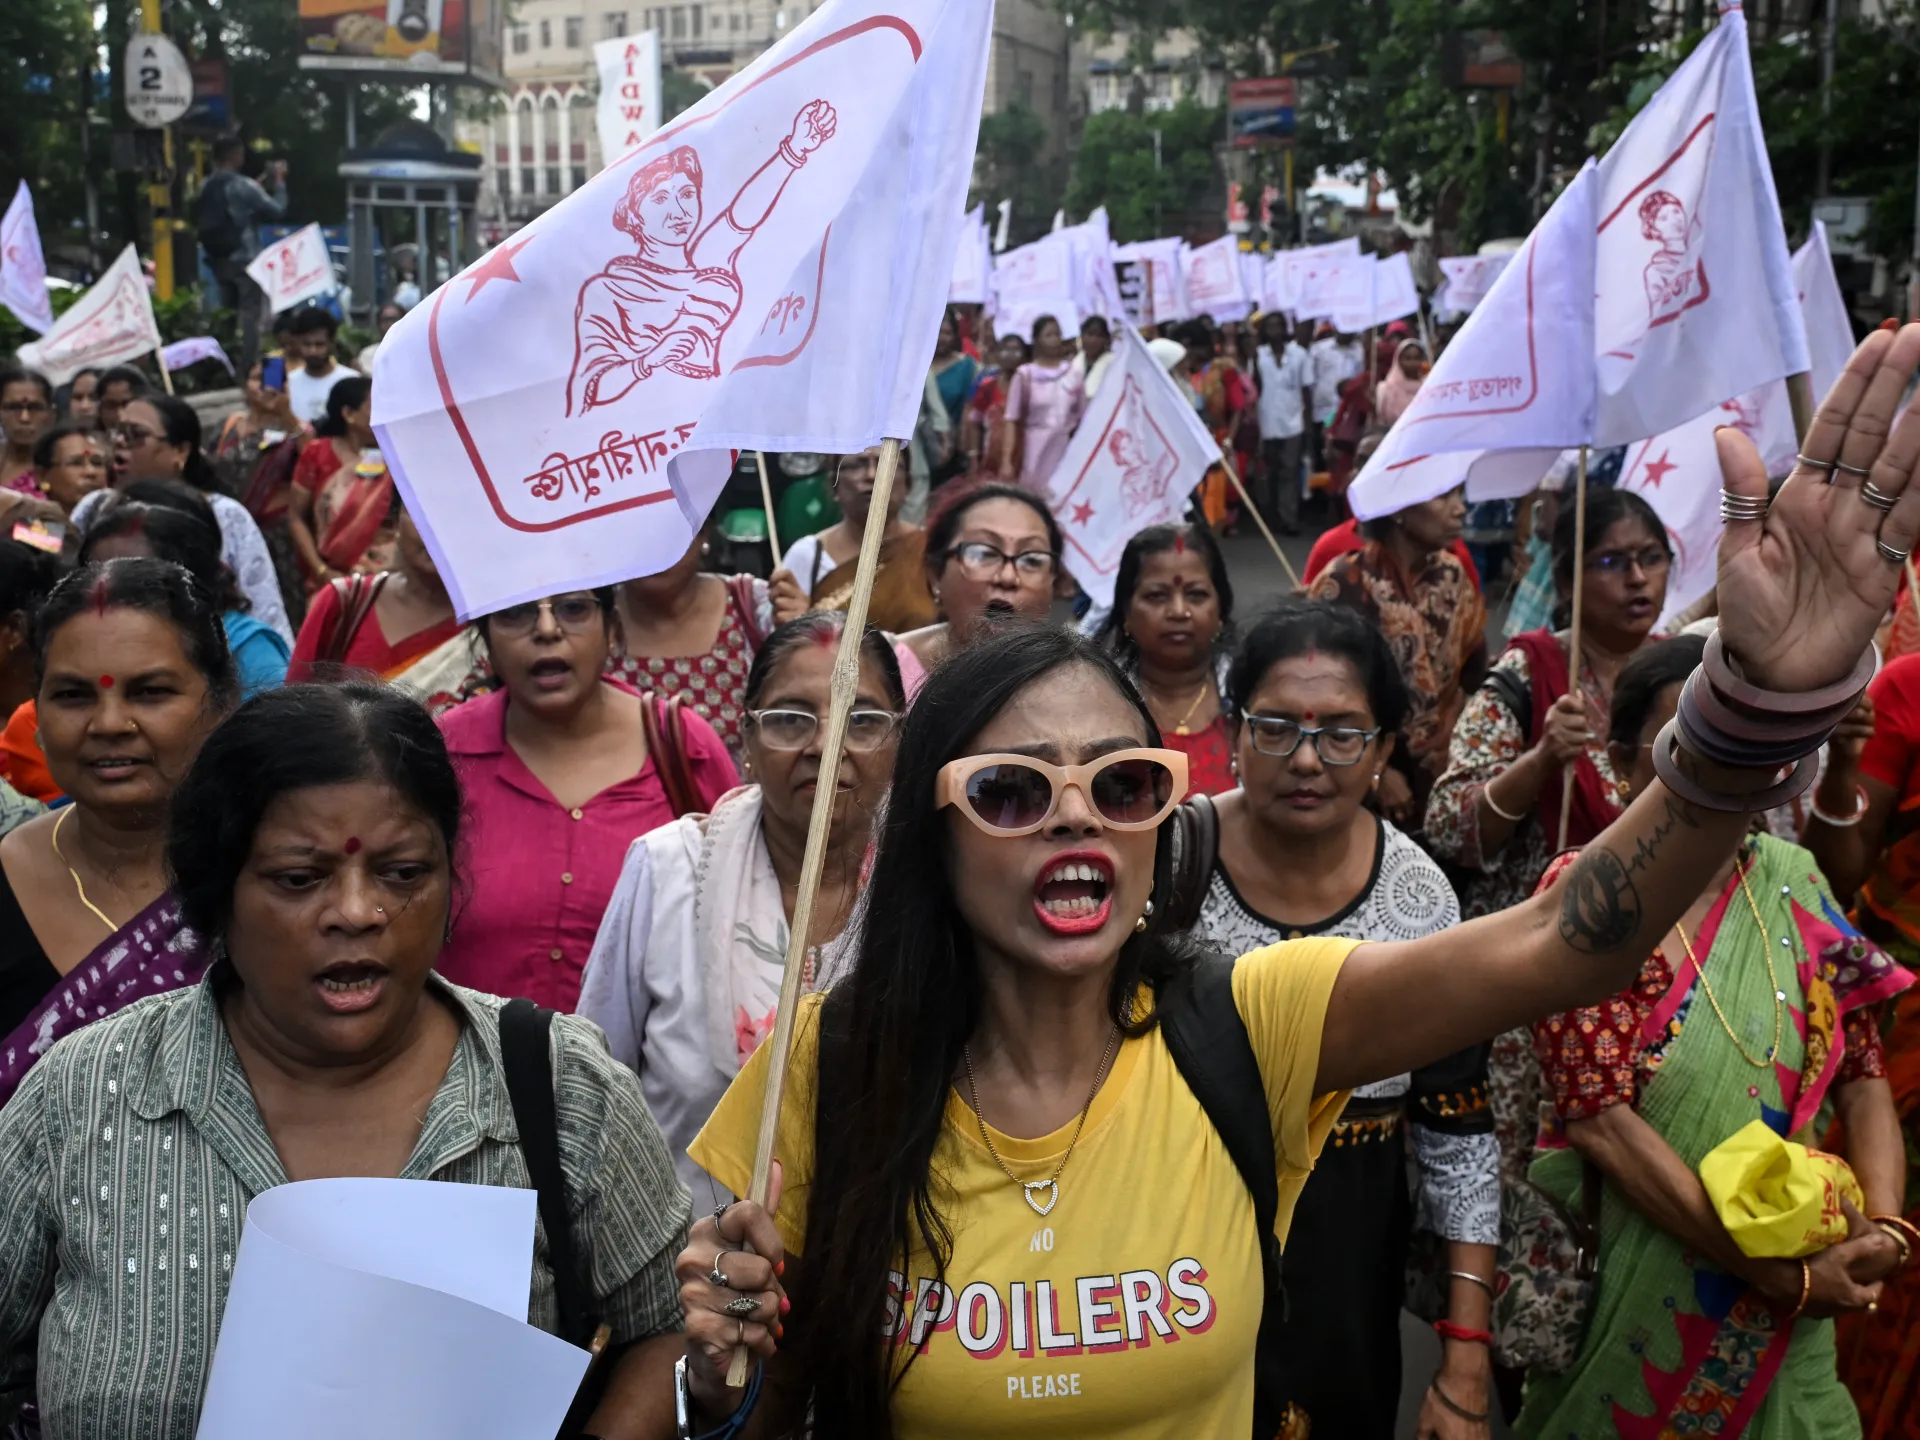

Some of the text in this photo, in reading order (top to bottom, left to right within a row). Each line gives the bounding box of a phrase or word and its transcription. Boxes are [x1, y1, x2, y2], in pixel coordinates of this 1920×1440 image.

[144, 47, 155, 58] A
[140, 67, 162, 90] 2
[1028, 1228, 1055, 1252] NO
[883, 1256, 1216, 1360] SPOILERS
[1007, 1373, 1082, 1399] PLEASE
